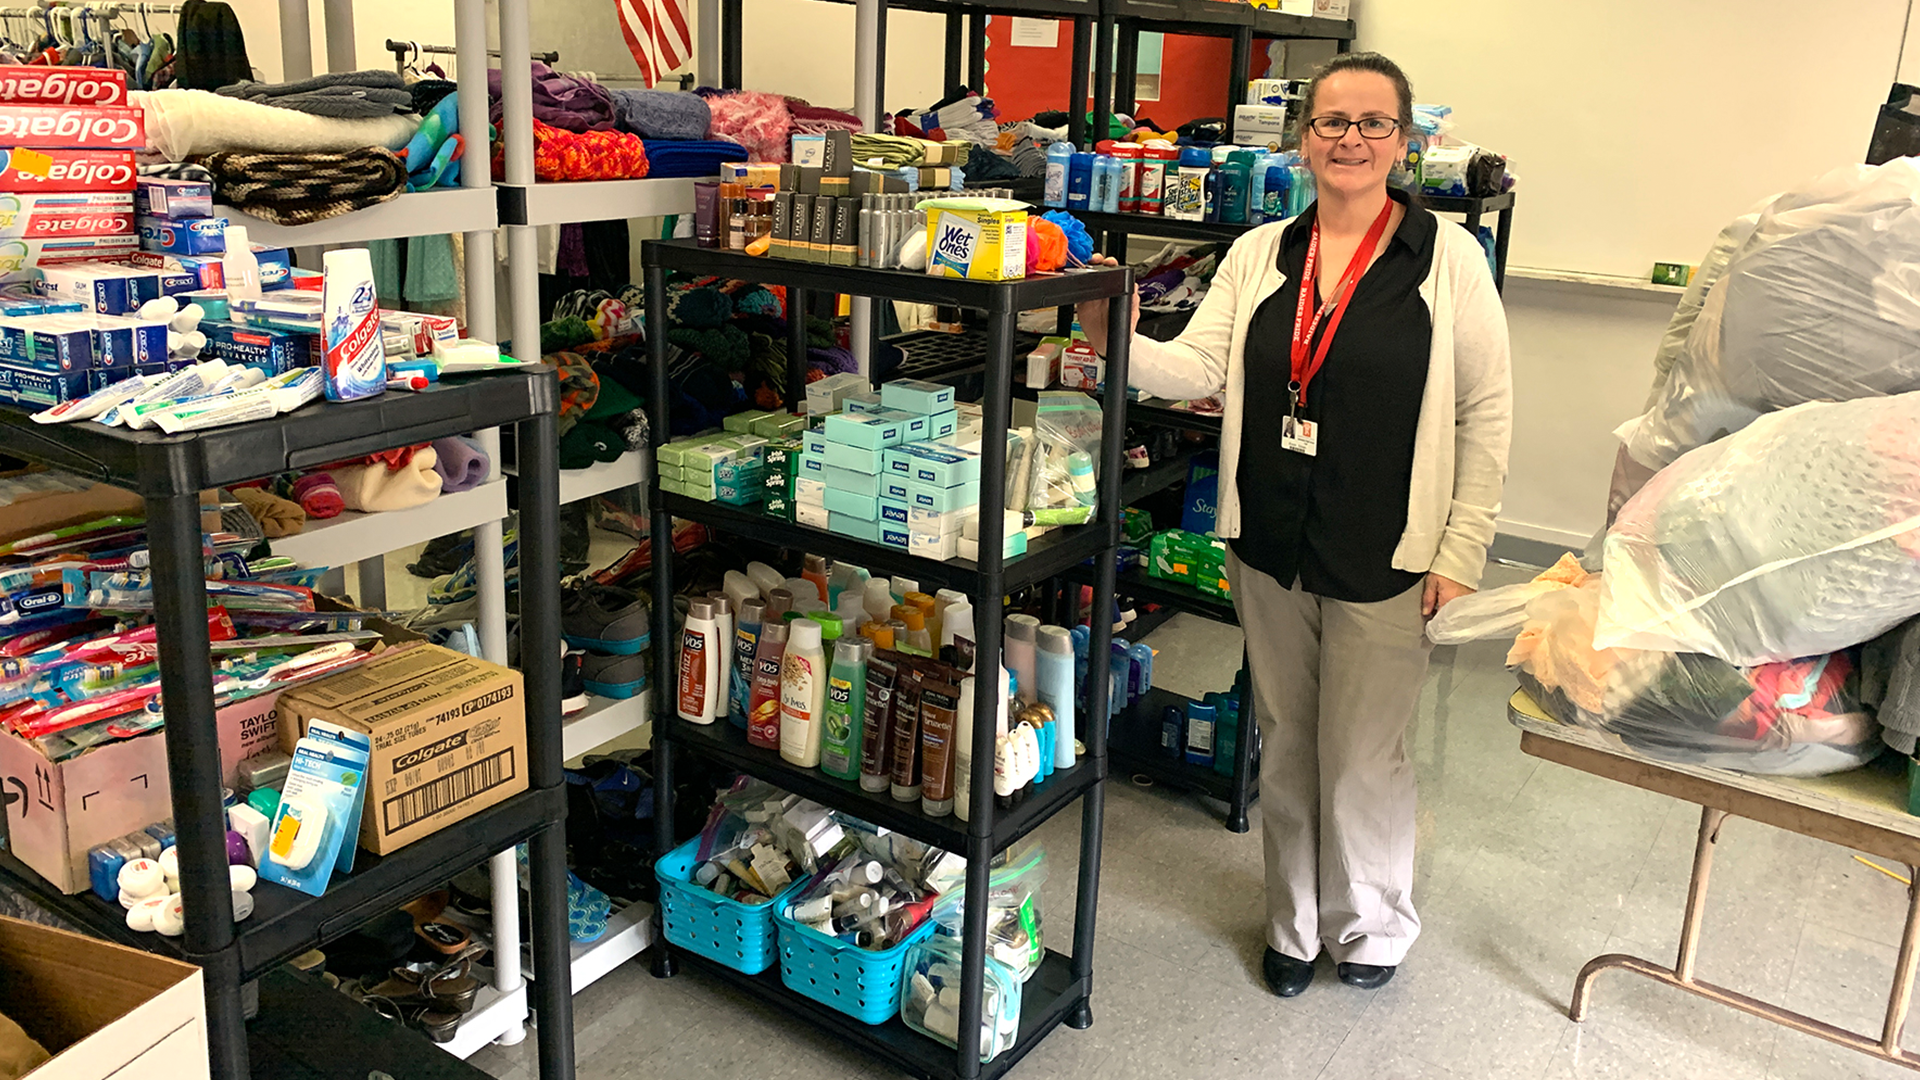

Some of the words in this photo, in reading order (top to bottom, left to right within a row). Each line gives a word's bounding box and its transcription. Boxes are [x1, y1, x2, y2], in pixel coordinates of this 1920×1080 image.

[0, 73, 120, 105] Colgat
[0, 111, 138, 143] Colgate
[824, 138, 833, 172] THANN
[35, 216, 128, 232] Colgate
[190, 221, 228, 232] Crest
[774, 201, 782, 234] THANN
[794, 203, 803, 236] THANN
[814, 205, 823, 239] THANN
[836, 206, 844, 240] THANN
[977, 217, 1000, 225] Singles
[139, 227, 176, 247] Cre
[946, 224, 974, 246] Wet
[938, 238, 970, 259] Ones
[131, 253, 163, 268] Colgate
[1303, 258, 1314, 282] PRIDE
[164, 276, 195, 287] Crest
[259, 268, 288, 276] Cres
[36, 280, 58, 292] Crest
[130, 279, 140, 310] Crest
[97, 282, 108, 314] Crest
[1297, 287, 1308, 317] RAIDER
[340, 308, 380, 359] Colgate
[1293, 316, 1303, 342] PRIDE
[60, 336, 72, 370] Crest
[104, 332, 114, 366] Crest
[138, 330, 148, 362] Crest
[216, 350, 268, 364] ADVANCED
[14, 379, 52, 390] ADVANCED
[58, 377, 70, 405] rest
[1086, 380, 1094, 388] 19
[766, 454, 786, 464] Spring
[771, 450, 783, 458] Irish
[766, 478, 786, 488] Spring
[770, 474, 782, 482] Irish
[768, 502, 786, 511] Spring
[885, 508, 906, 522] lever
[1192, 498, 1218, 519] Stay
[886, 534, 908, 546] lever
[684, 635, 702, 650] VO5
[738, 638, 752, 652] VO5
[682, 653, 690, 694] anti-frizz
[760, 660, 778, 674] VO5
[476, 687, 512, 709] 0174193
[830, 688, 849, 701] VO5
[240, 710, 278, 730] TAYLO
[436, 707, 460, 726] 74193
[240, 720, 276, 741] SWIFT
[376, 739, 393, 752] TRIAL
[394, 734, 407, 745] SIZE
[408, 726, 426, 742] TUBES
[396, 734, 462, 768] Colgate
[295, 758, 322, 770] HI-TECH
